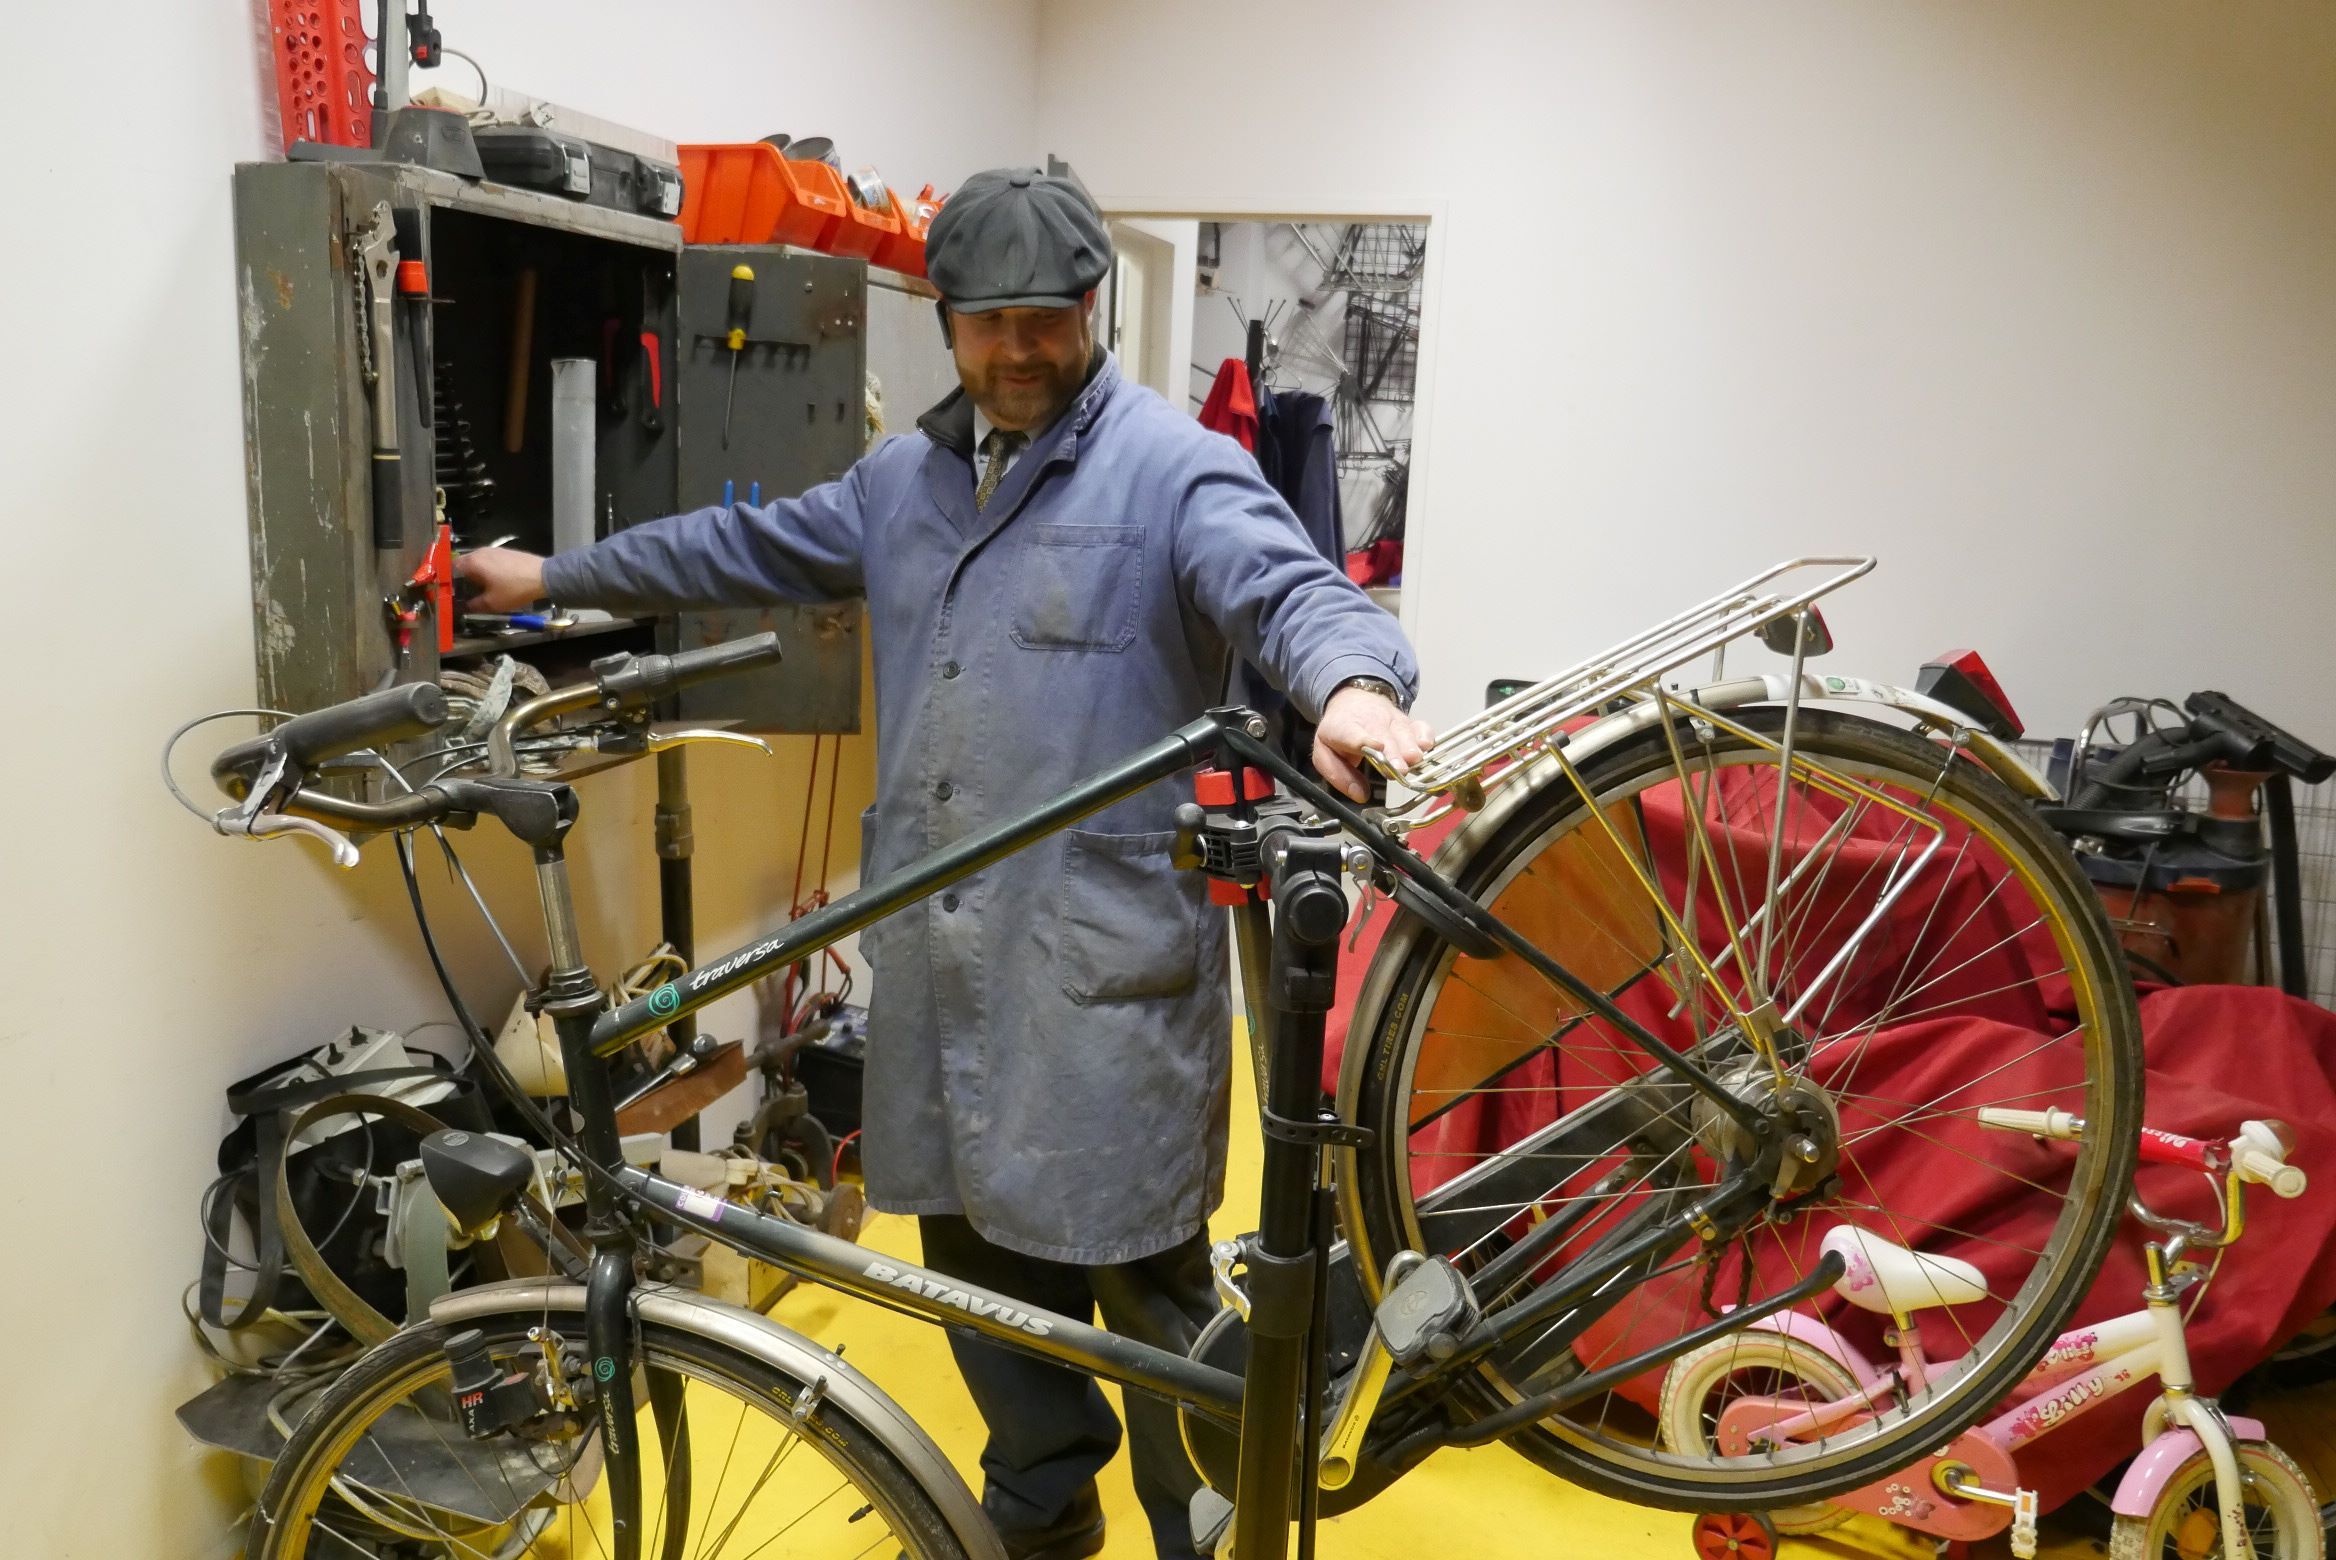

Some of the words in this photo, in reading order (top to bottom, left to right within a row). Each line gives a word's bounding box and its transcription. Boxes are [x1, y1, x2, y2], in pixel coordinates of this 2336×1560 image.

[689, 938, 784, 990] traversa
[862, 1261, 1056, 1337] BATAVUS
[461, 1391, 484, 1409] HR
[2040, 1377, 2104, 1428] Lilly
